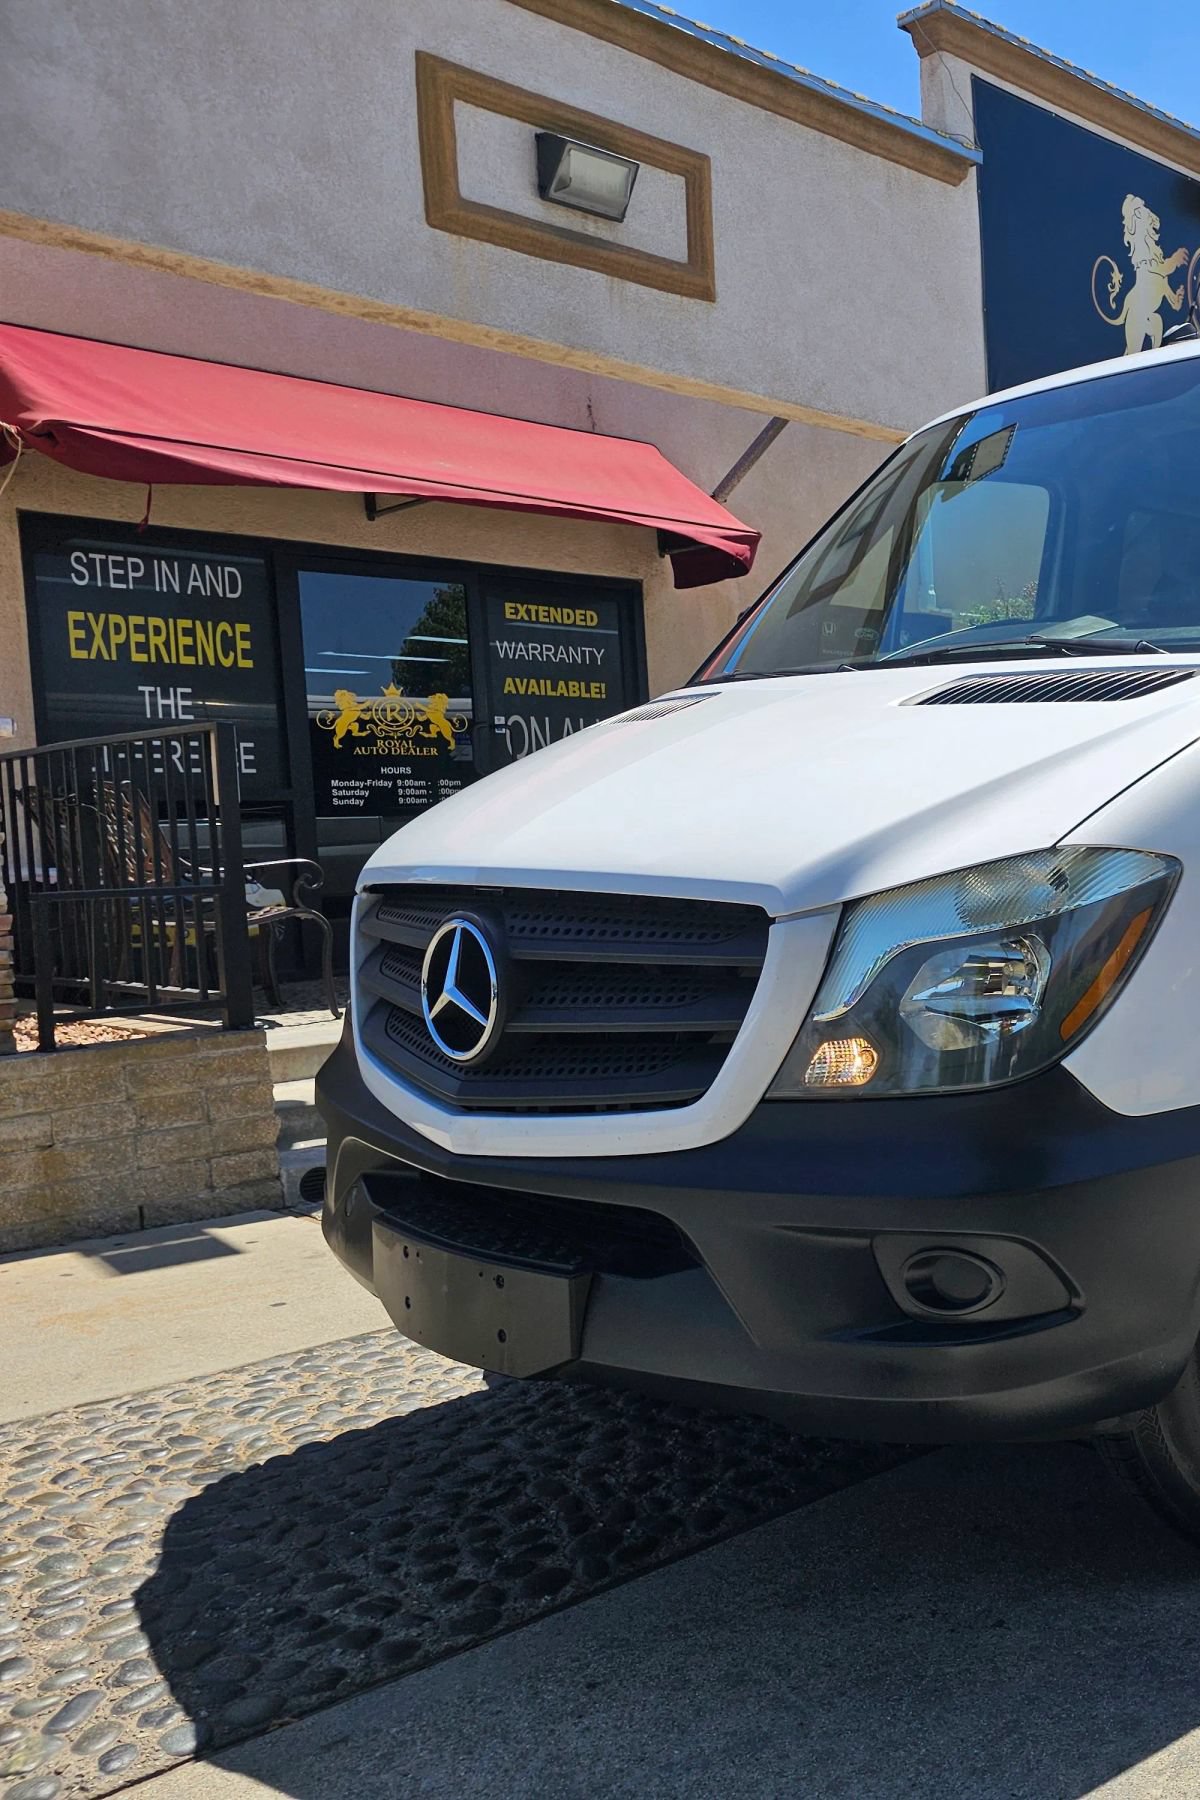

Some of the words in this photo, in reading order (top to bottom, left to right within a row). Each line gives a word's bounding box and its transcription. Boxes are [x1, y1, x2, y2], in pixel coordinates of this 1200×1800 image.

[70, 551, 145, 590] STEP
[153, 560, 181, 594] IN
[187, 563, 243, 598] AND
[504, 602, 599, 627] EXTENDED
[67, 610, 254, 668] EXPERIENCE
[495, 640, 605, 666] WARRANTY
[503, 677, 607, 699] AVAILABLE!
[138, 685, 194, 720] THE
[386, 702, 405, 721] R
[353, 747, 388, 755] AUTO
[391, 747, 438, 756] DEALER
[377, 739, 416, 748] ROYAL
[380, 766, 412, 774] HOURS
[331, 779, 393, 788] Monday-Friday
[332, 789, 369, 797] Saturday
[332, 798, 365, 806] Sunday
